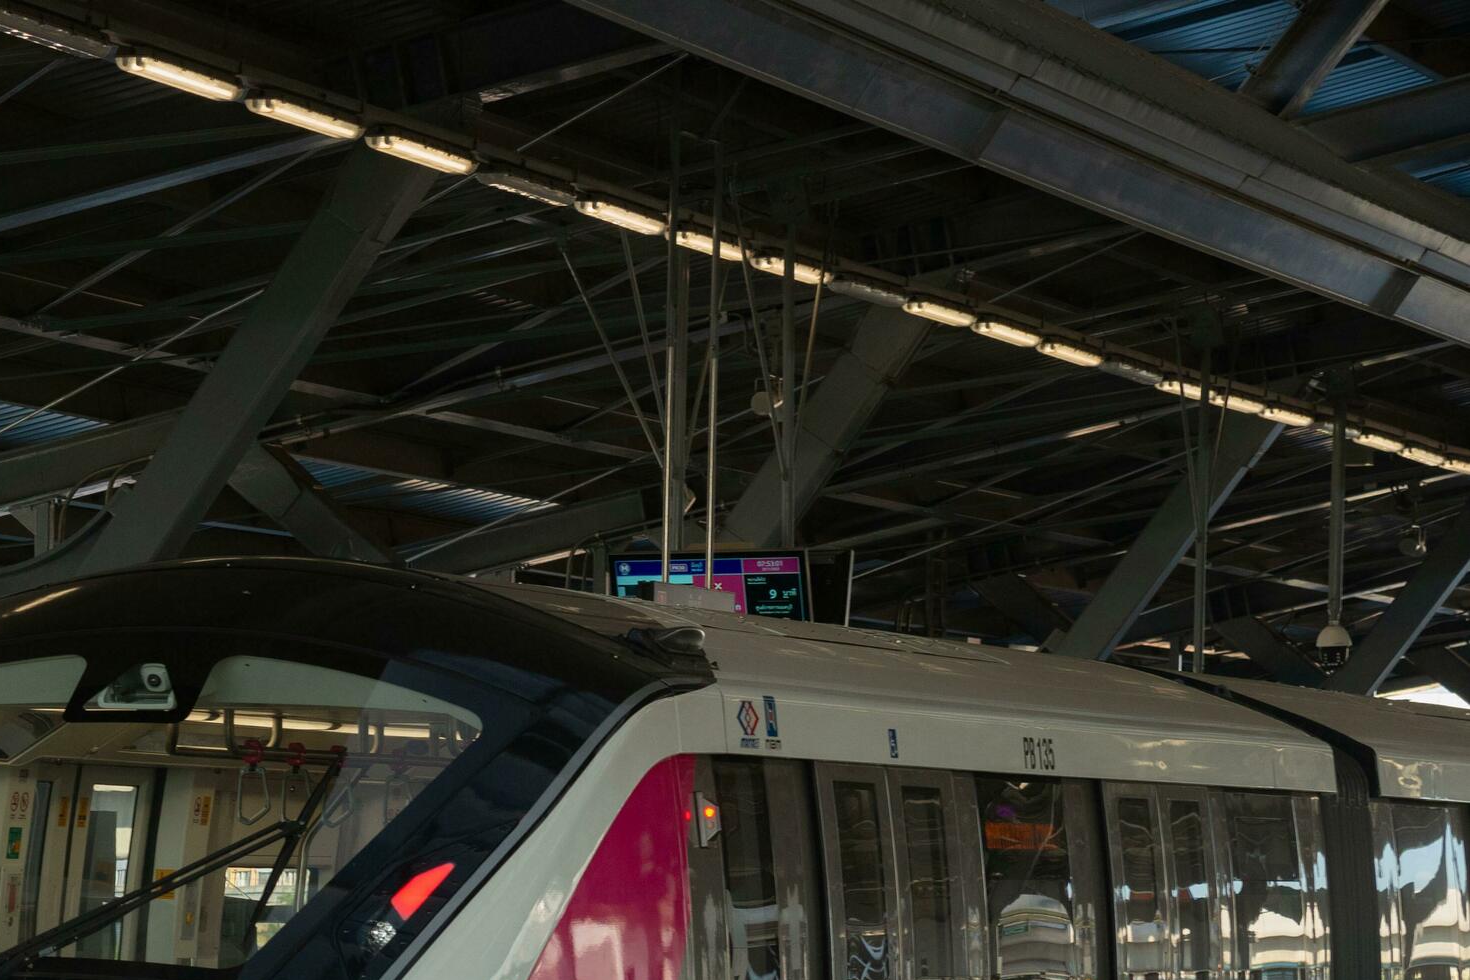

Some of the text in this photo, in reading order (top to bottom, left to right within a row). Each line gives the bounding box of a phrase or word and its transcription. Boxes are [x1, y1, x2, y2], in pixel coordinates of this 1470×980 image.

[769, 588, 778, 600] 9
[1023, 736, 1056, 771] PB 135
